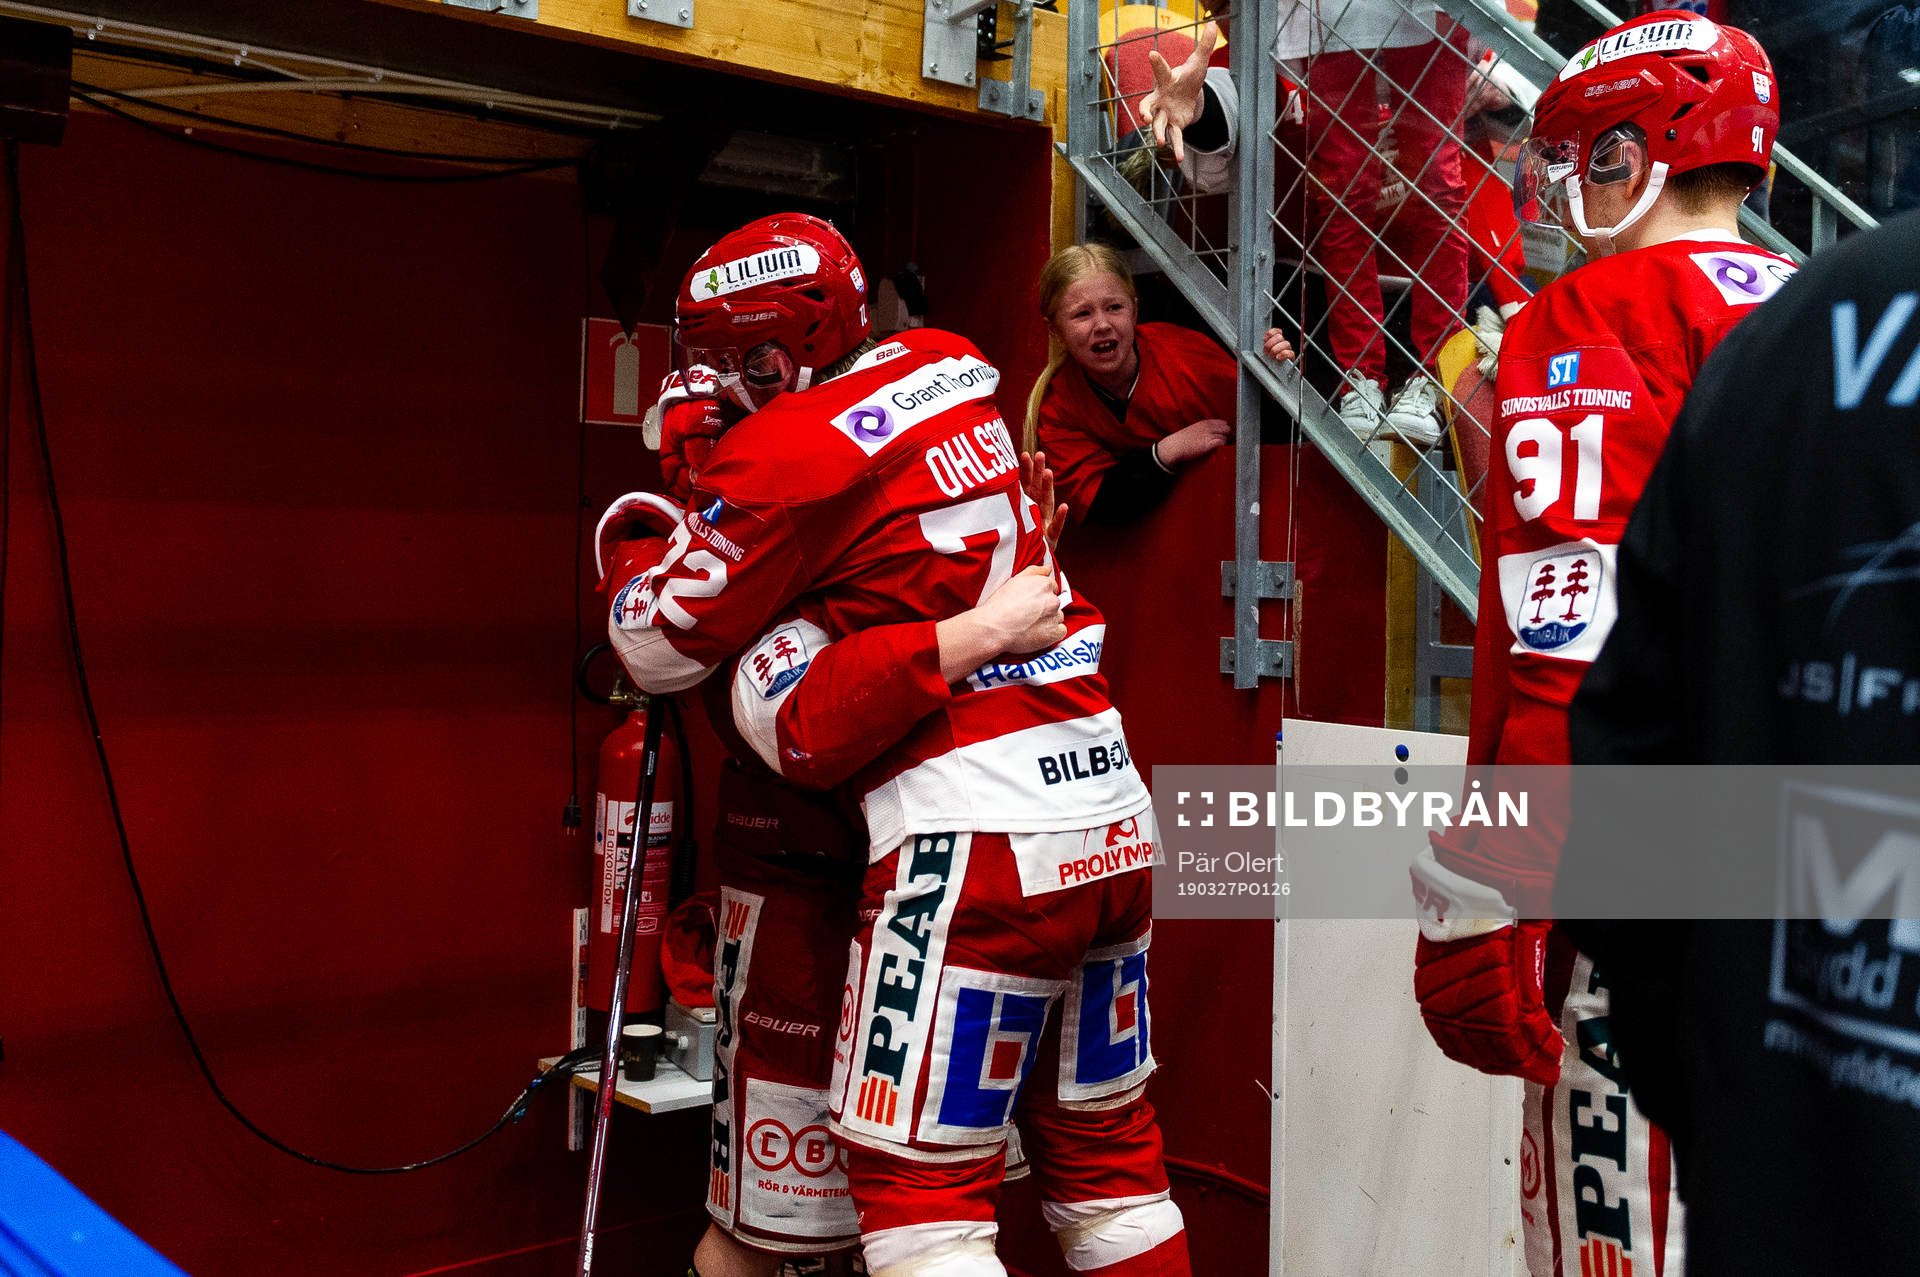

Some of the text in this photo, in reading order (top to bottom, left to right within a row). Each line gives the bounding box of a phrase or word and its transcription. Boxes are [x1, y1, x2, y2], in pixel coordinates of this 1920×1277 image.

[1601, 23, 1693, 55] LILIUM
[1751, 126, 1764, 154] 91
[726, 249, 802, 285] LILIUM
[1549, 354, 1578, 386] ST
[891, 379, 951, 411] Grant
[1501, 388, 1632, 418] SUNDSVALLS TIDNING
[1505, 414, 1604, 522] 91
[708, 526, 745, 563] TIDNING
[728, 813, 780, 830] BAUER
[604, 828, 616, 905] KOLDIOXID B
[863, 832, 956, 1086] PEAB
[744, 1011, 821, 1038] BAUER
[758, 1179, 780, 1193] RÖR
[792, 1185, 850, 1198] VÄRMETEK
